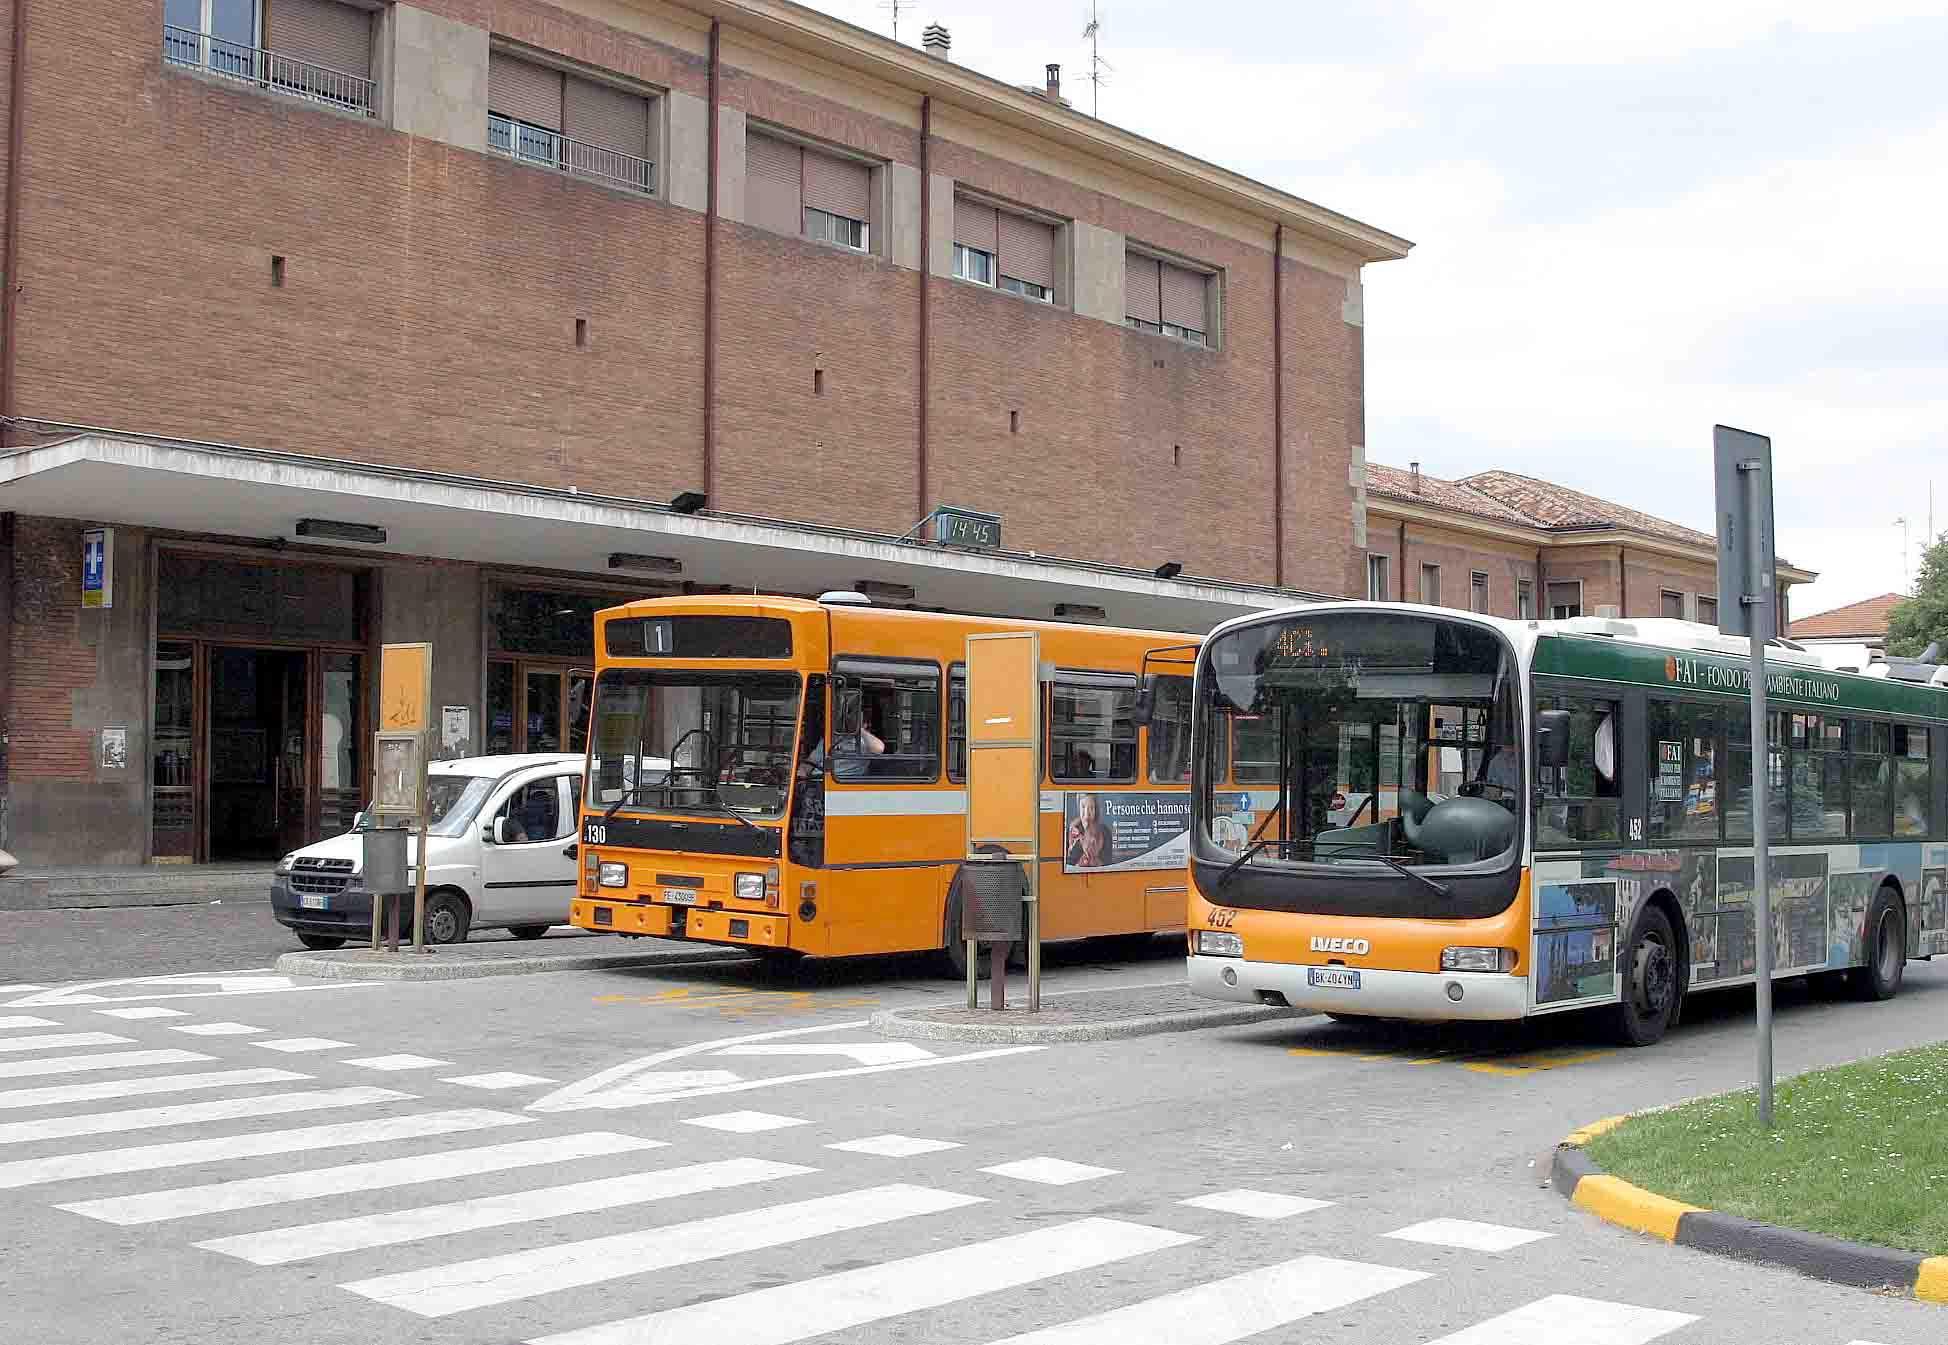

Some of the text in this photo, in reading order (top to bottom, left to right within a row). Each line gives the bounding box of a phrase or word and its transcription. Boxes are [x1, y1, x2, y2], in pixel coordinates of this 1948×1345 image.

[1675, 657, 1697, 684] FAI
[1707, 666, 1741, 688] FONDO
[1805, 679, 1839, 701] ITALIANO
[1667, 744, 1681, 761] FAI
[1105, 800, 1140, 815] Persone
[1141, 799, 1156, 815] che
[1157, 799, 1183, 815] hanno
[587, 824, 606, 844] 130
[1629, 818, 1642, 841] 452
[1207, 908, 1238, 929] 452
[1310, 935, 1370, 956] IVECO
